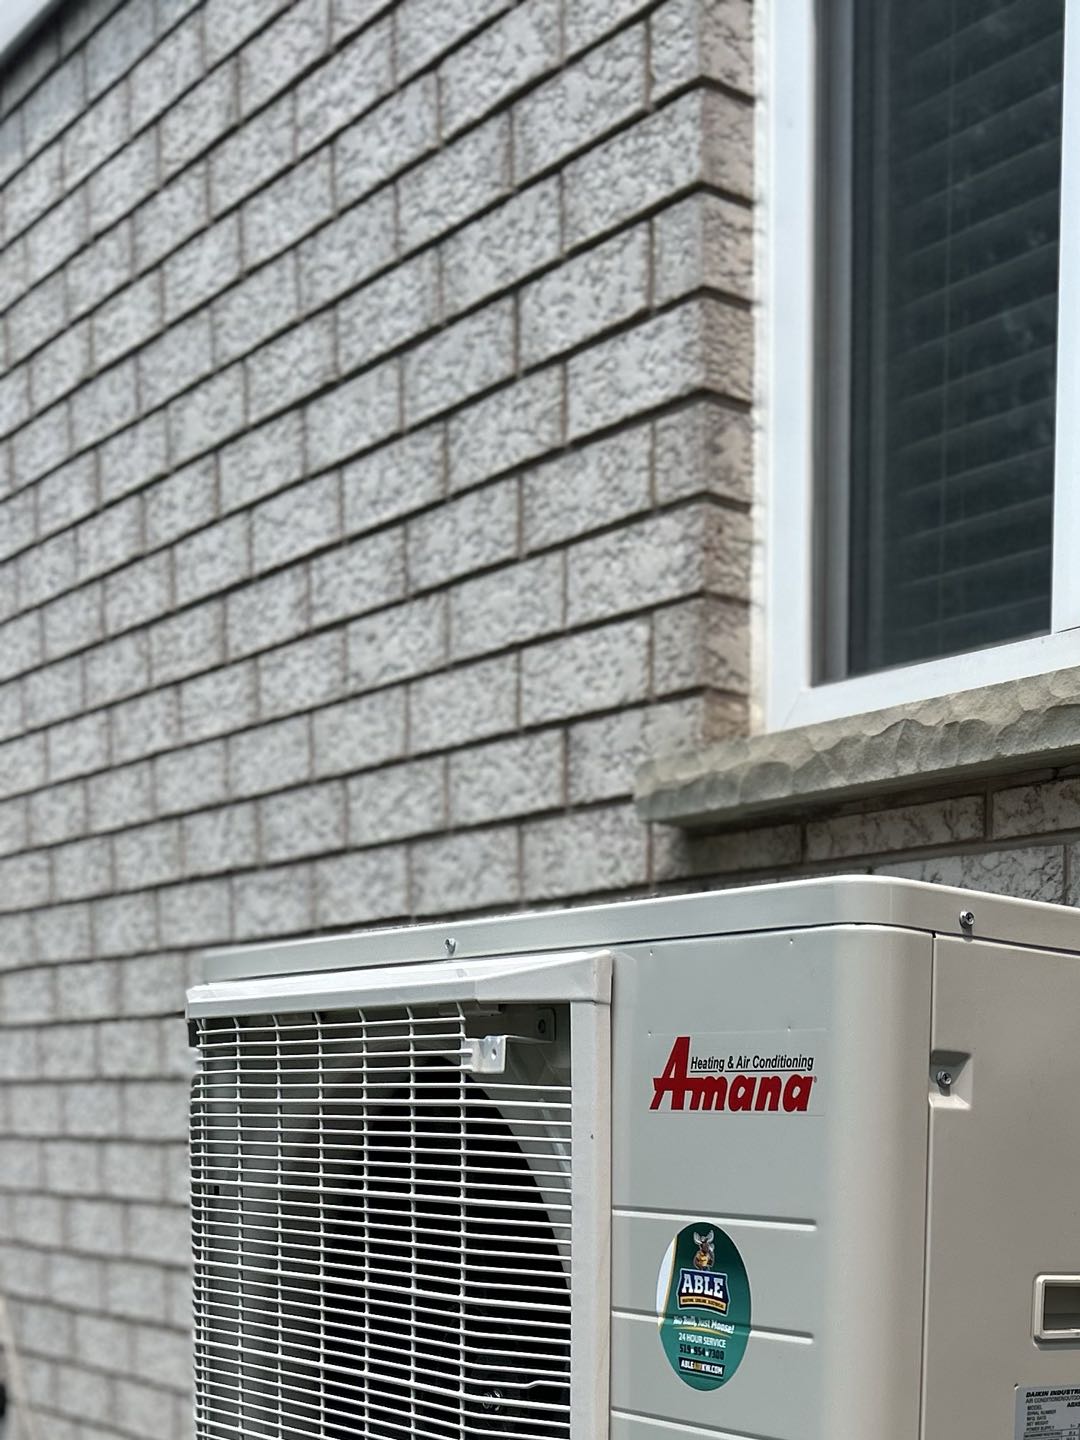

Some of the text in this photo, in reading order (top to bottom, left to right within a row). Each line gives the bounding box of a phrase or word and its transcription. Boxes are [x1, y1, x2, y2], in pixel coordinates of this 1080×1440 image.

[690, 1054, 814, 1072] Heating & Air Conditioning
[681, 1273, 724, 1299] ABLE
[678, 1332, 727, 1349] 24 HOUR SERVICE
